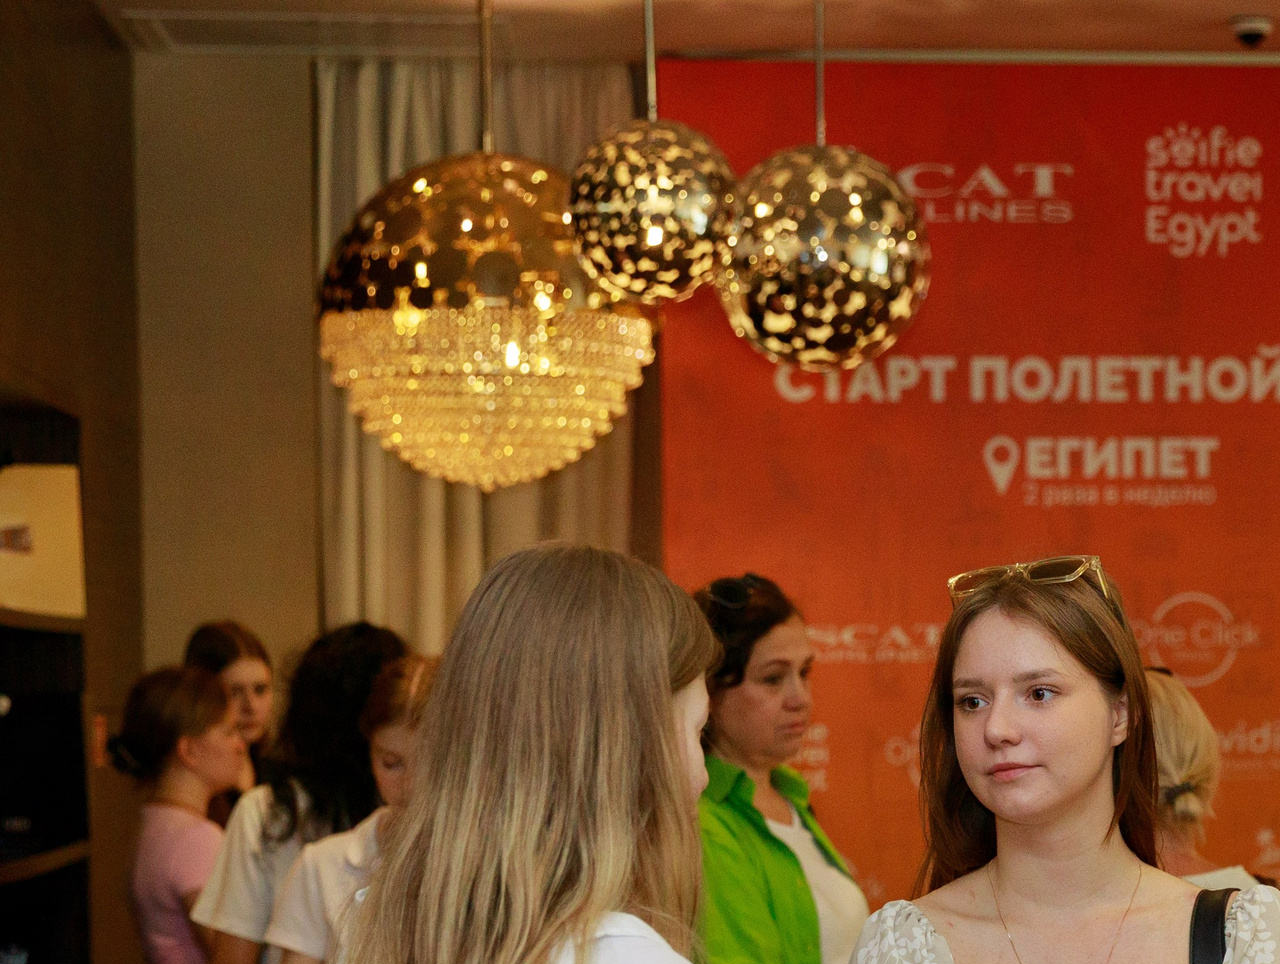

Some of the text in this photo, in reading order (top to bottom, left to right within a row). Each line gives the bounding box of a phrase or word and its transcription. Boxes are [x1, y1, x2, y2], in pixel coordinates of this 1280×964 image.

[900, 162, 1075, 198] CAT
[1145, 170, 1263, 202] travel
[924, 201, 1074, 223] LINES
[1146, 205, 1262, 257] Egypt
[1024, 436, 1220, 479] ЕГИПЕТ
[1191, 619, 1260, 649] Click
